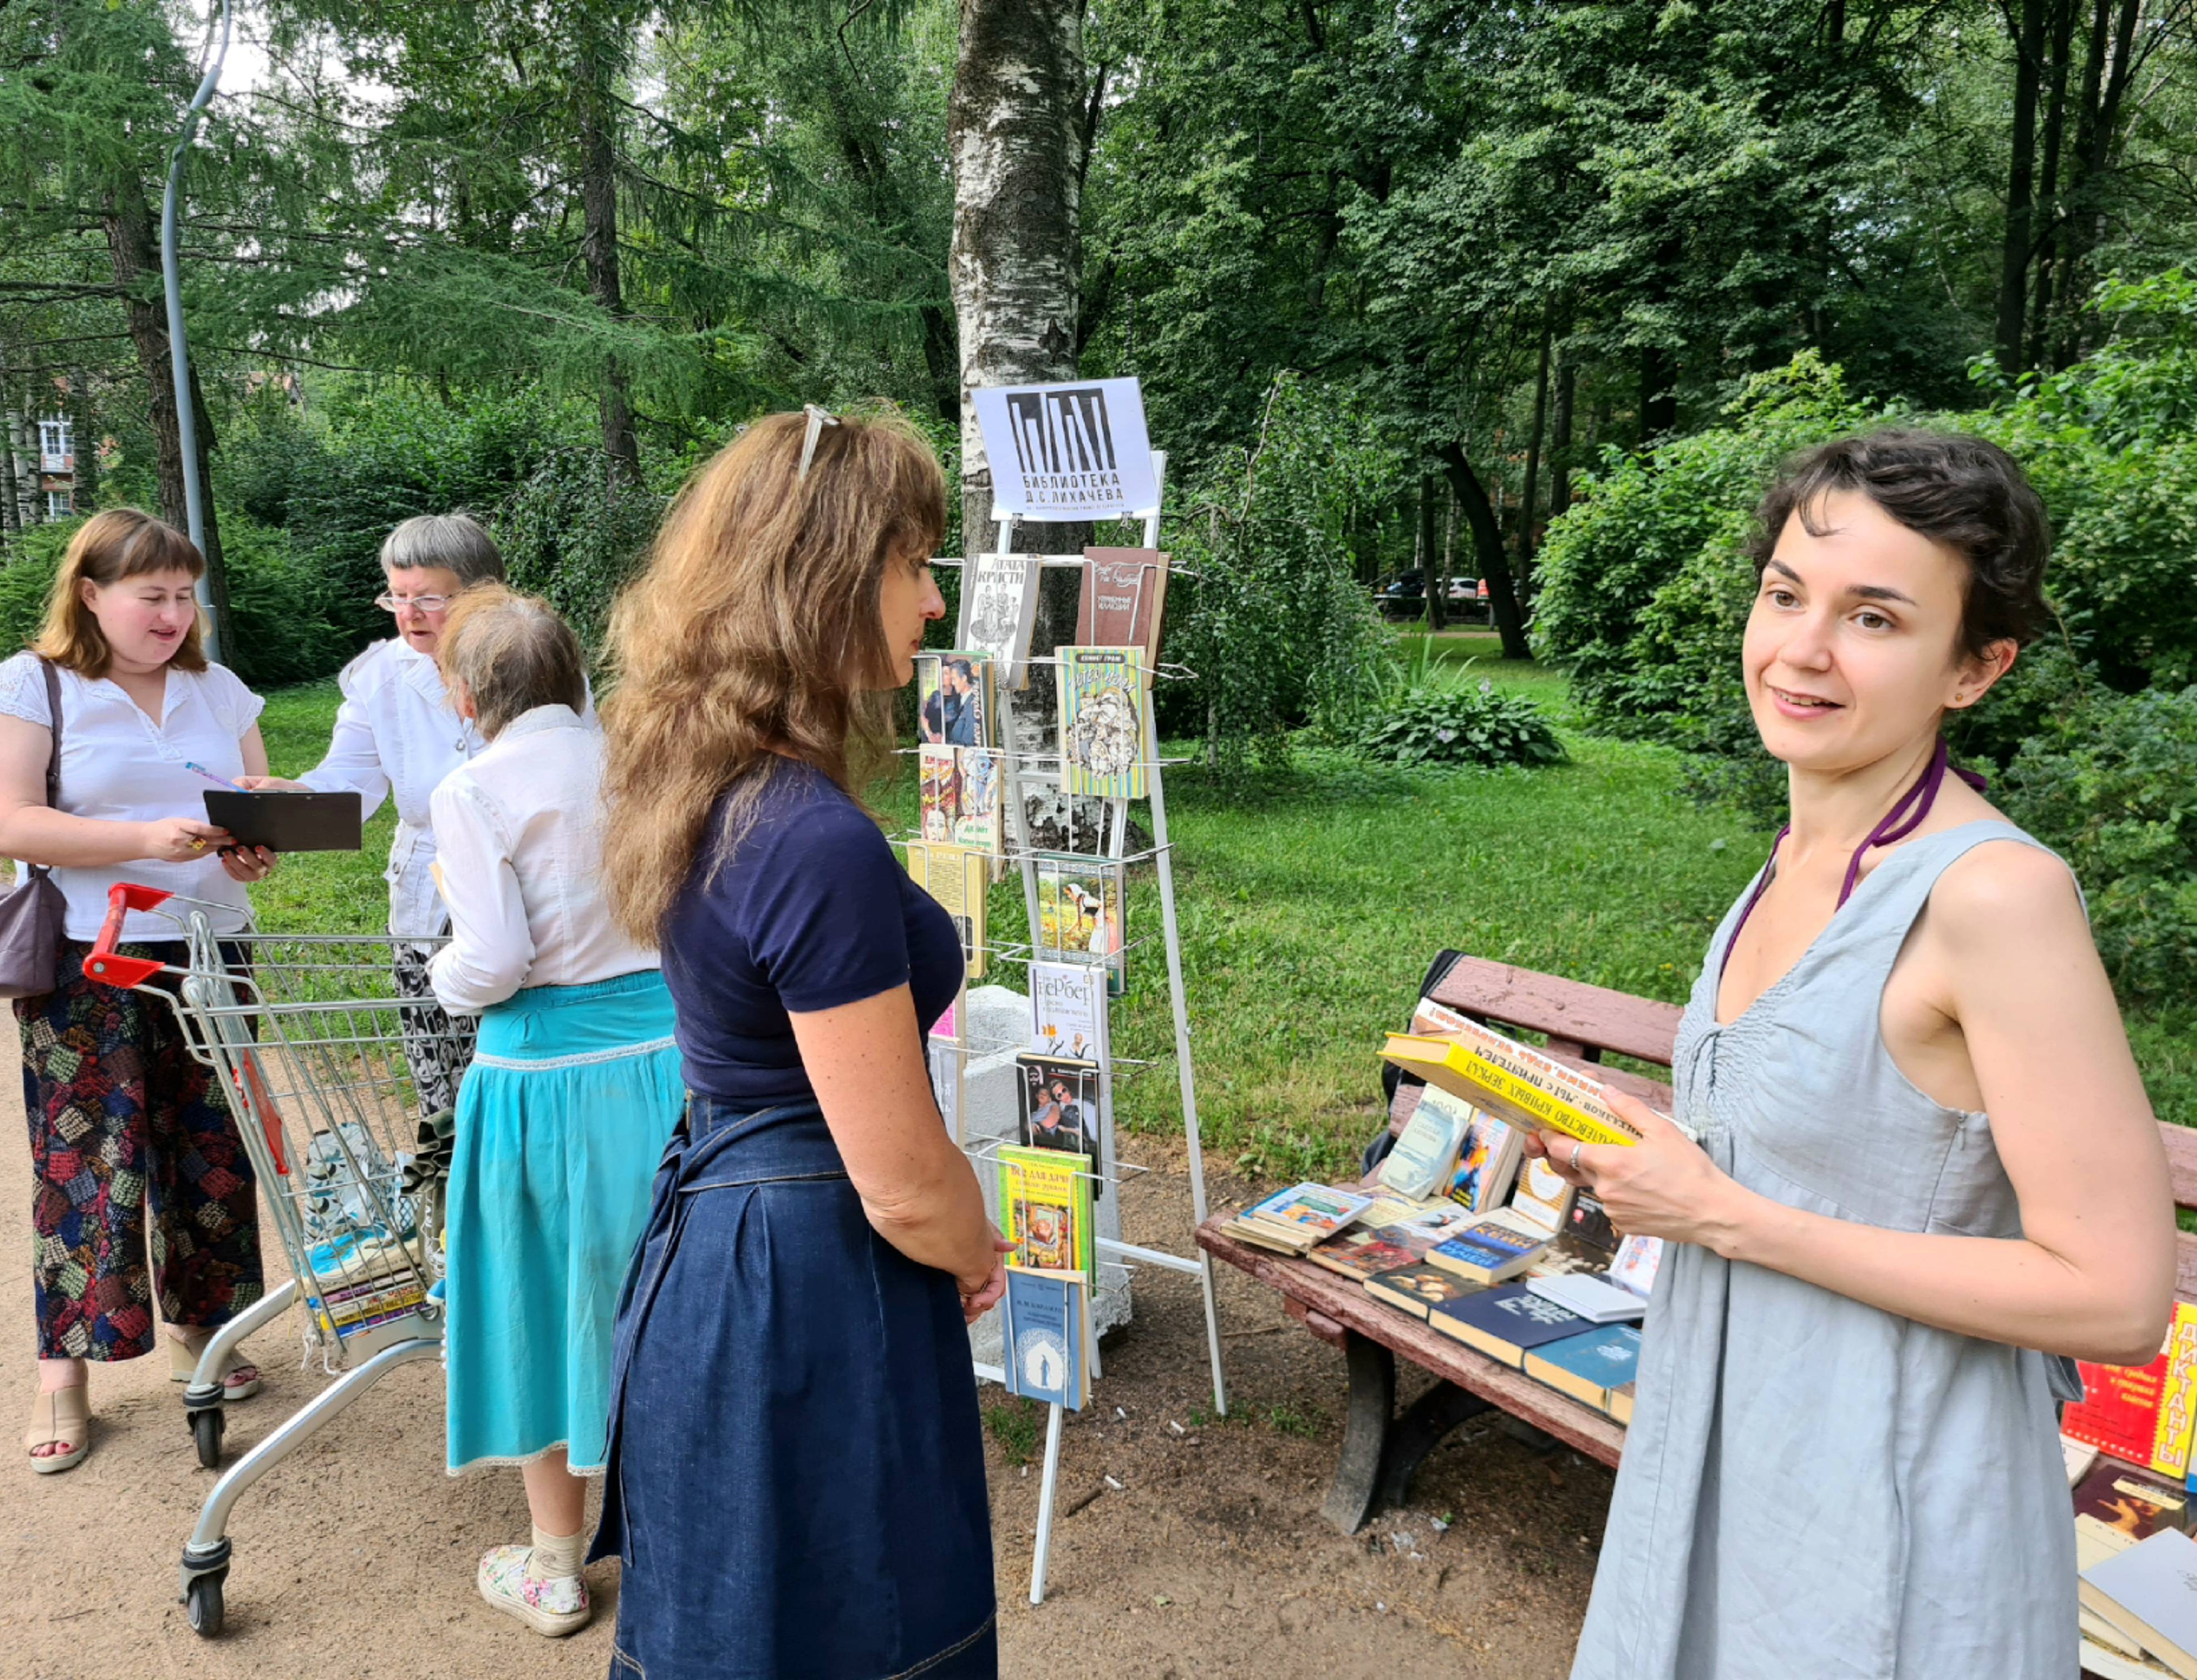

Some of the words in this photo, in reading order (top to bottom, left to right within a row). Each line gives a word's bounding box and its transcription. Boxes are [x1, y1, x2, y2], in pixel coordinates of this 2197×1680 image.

[1022, 472, 1120, 489] БИБЛИОТЕКА
[1464, 1059, 1506, 1091] ЗЕРКАЛ
[1474, 1045, 1544, 1088] ПРИЯТЕЛЕМ
[1507, 1082, 1554, 1116] КРИВЫХ
[2159, 1321, 2197, 1468] ДИКТАНТЫ
